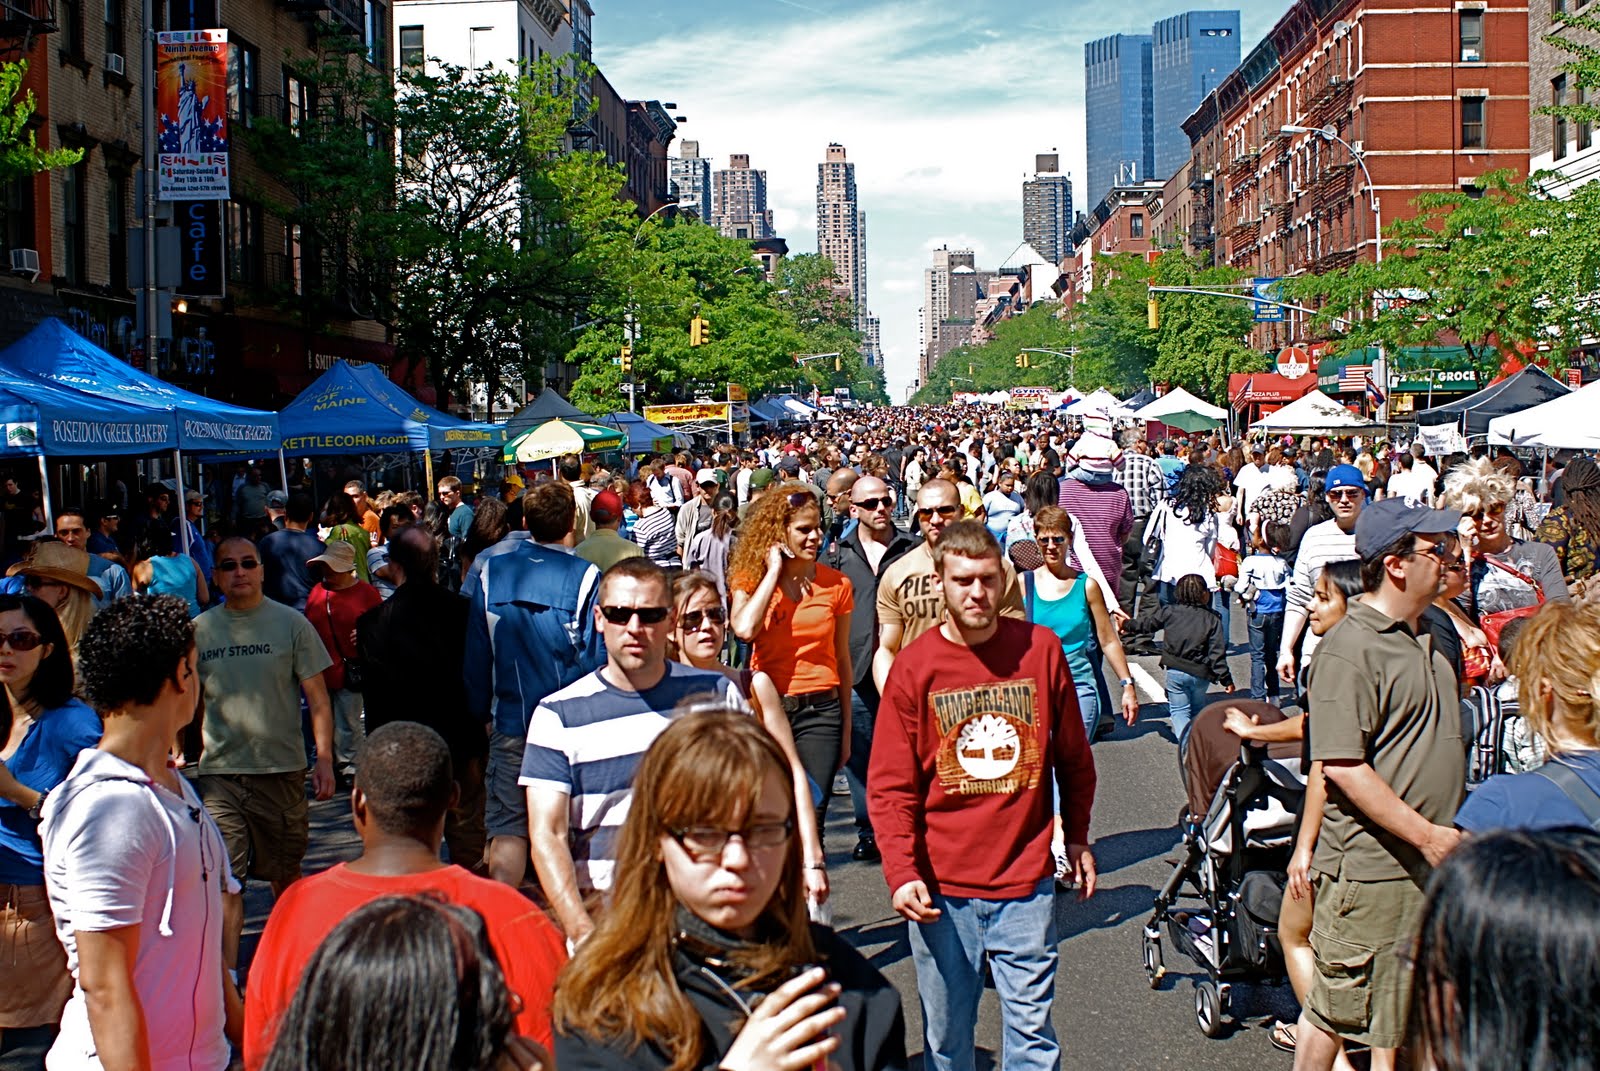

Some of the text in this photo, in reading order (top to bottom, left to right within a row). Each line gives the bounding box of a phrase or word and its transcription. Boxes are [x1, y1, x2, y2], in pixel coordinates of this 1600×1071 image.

[165, 44, 219, 53] Ninth Avenue
[188, 202, 207, 282] cafe
[312, 398, 368, 412] MAINE
[316, 391, 340, 404] OF
[53, 420, 102, 443] POSEIDON
[103, 422, 134, 443] GREEK
[134, 424, 168, 443] BAKERY
[222, 423, 246, 440] GREEK
[245, 424, 272, 441] BAKERY
[282, 435, 409, 451] KETTLECORN.com
[588, 439, 621, 452] LEMONADE
[904, 597, 939, 619] OUT
[201, 643, 273, 662] ARMY STRONG.
[934, 685, 1033, 735] TIMBERLAND
